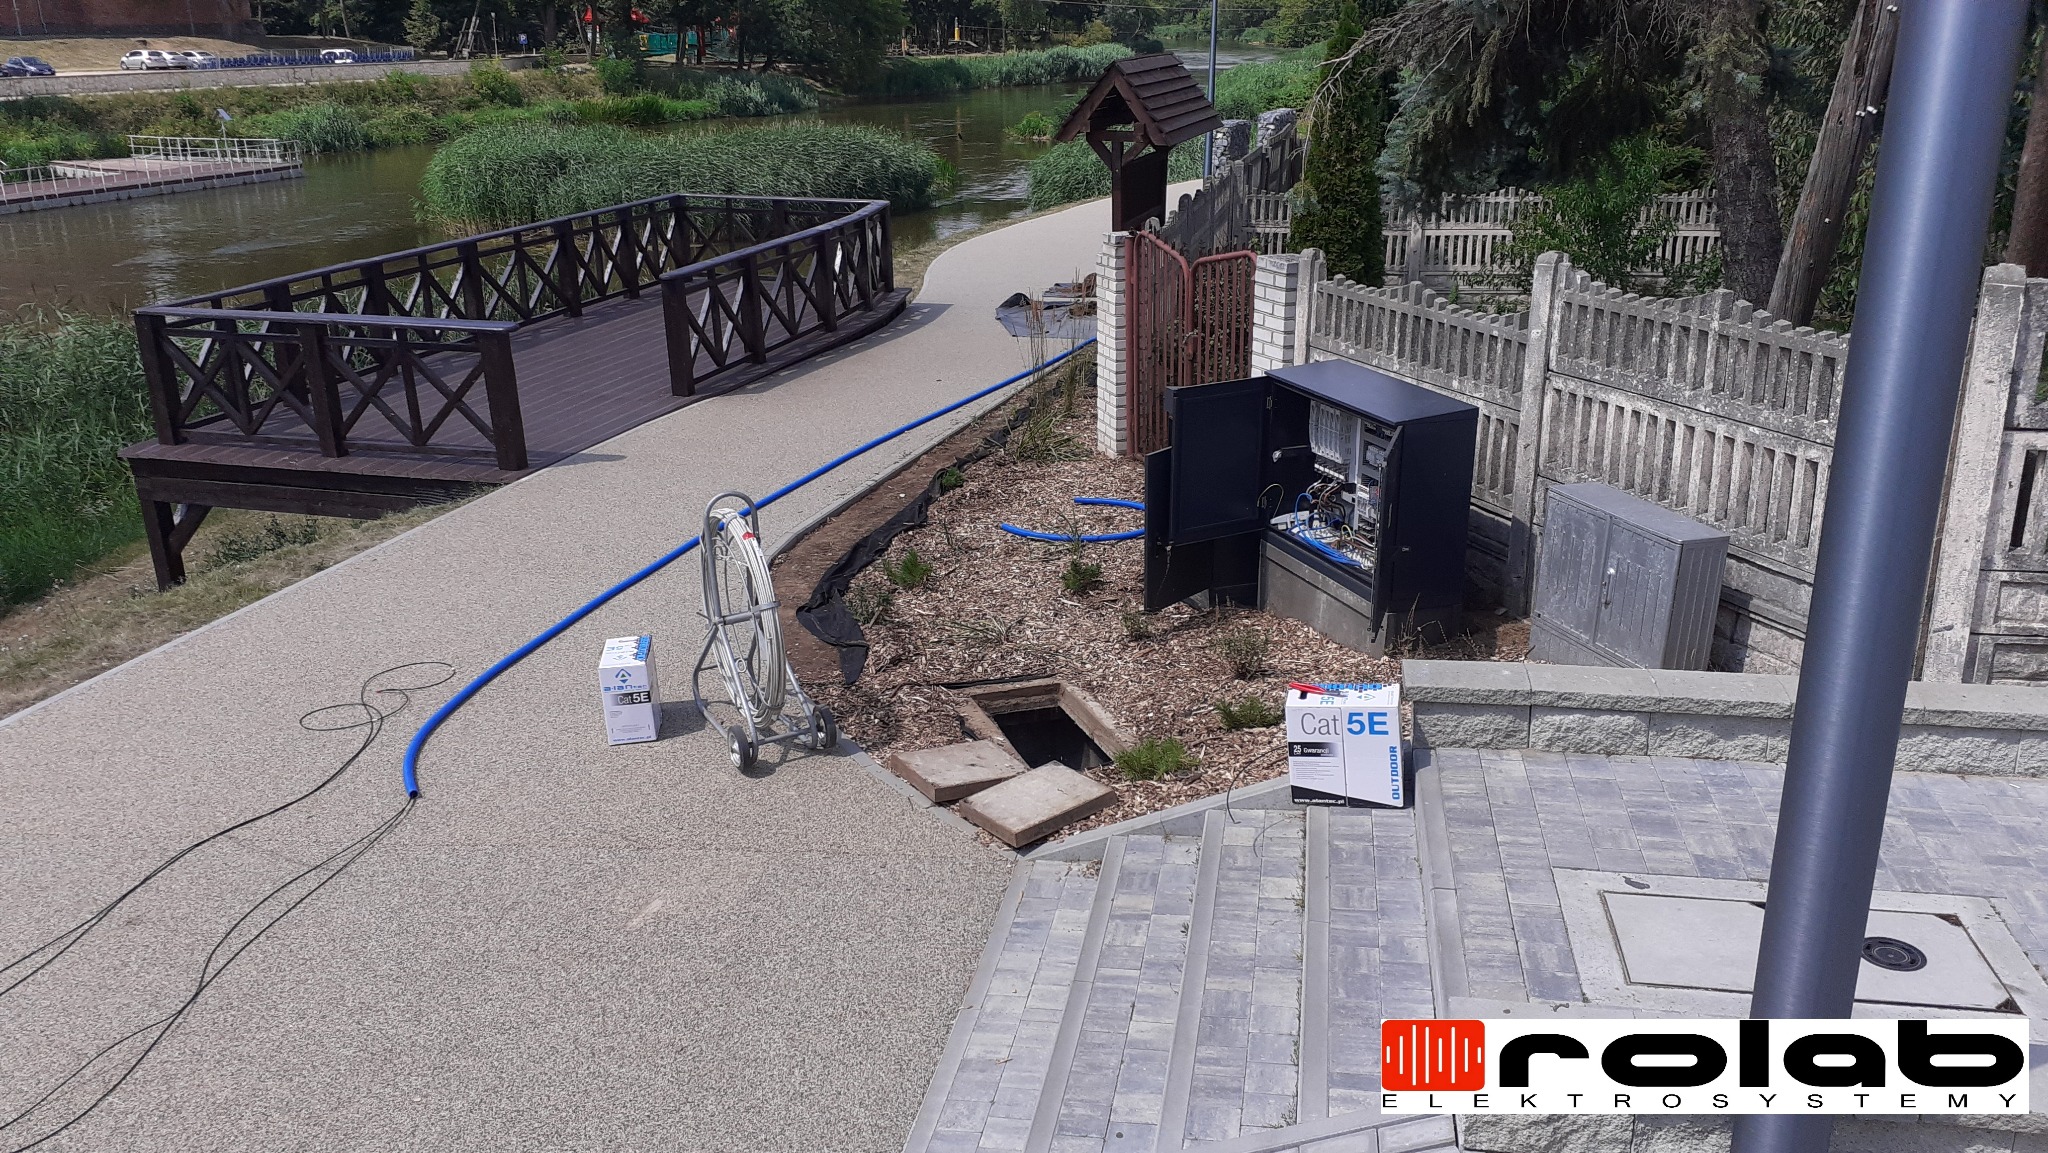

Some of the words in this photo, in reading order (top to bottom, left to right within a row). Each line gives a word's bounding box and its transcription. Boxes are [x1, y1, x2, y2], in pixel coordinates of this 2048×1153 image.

[617, 695, 632, 705] Cat
[632, 692, 650, 703] 5E
[1301, 712, 1341, 736] Cat
[1346, 711, 1389, 736] 5E
[1293, 744, 1302, 753] 25
[1389, 745, 1400, 800] OUTDOOR
